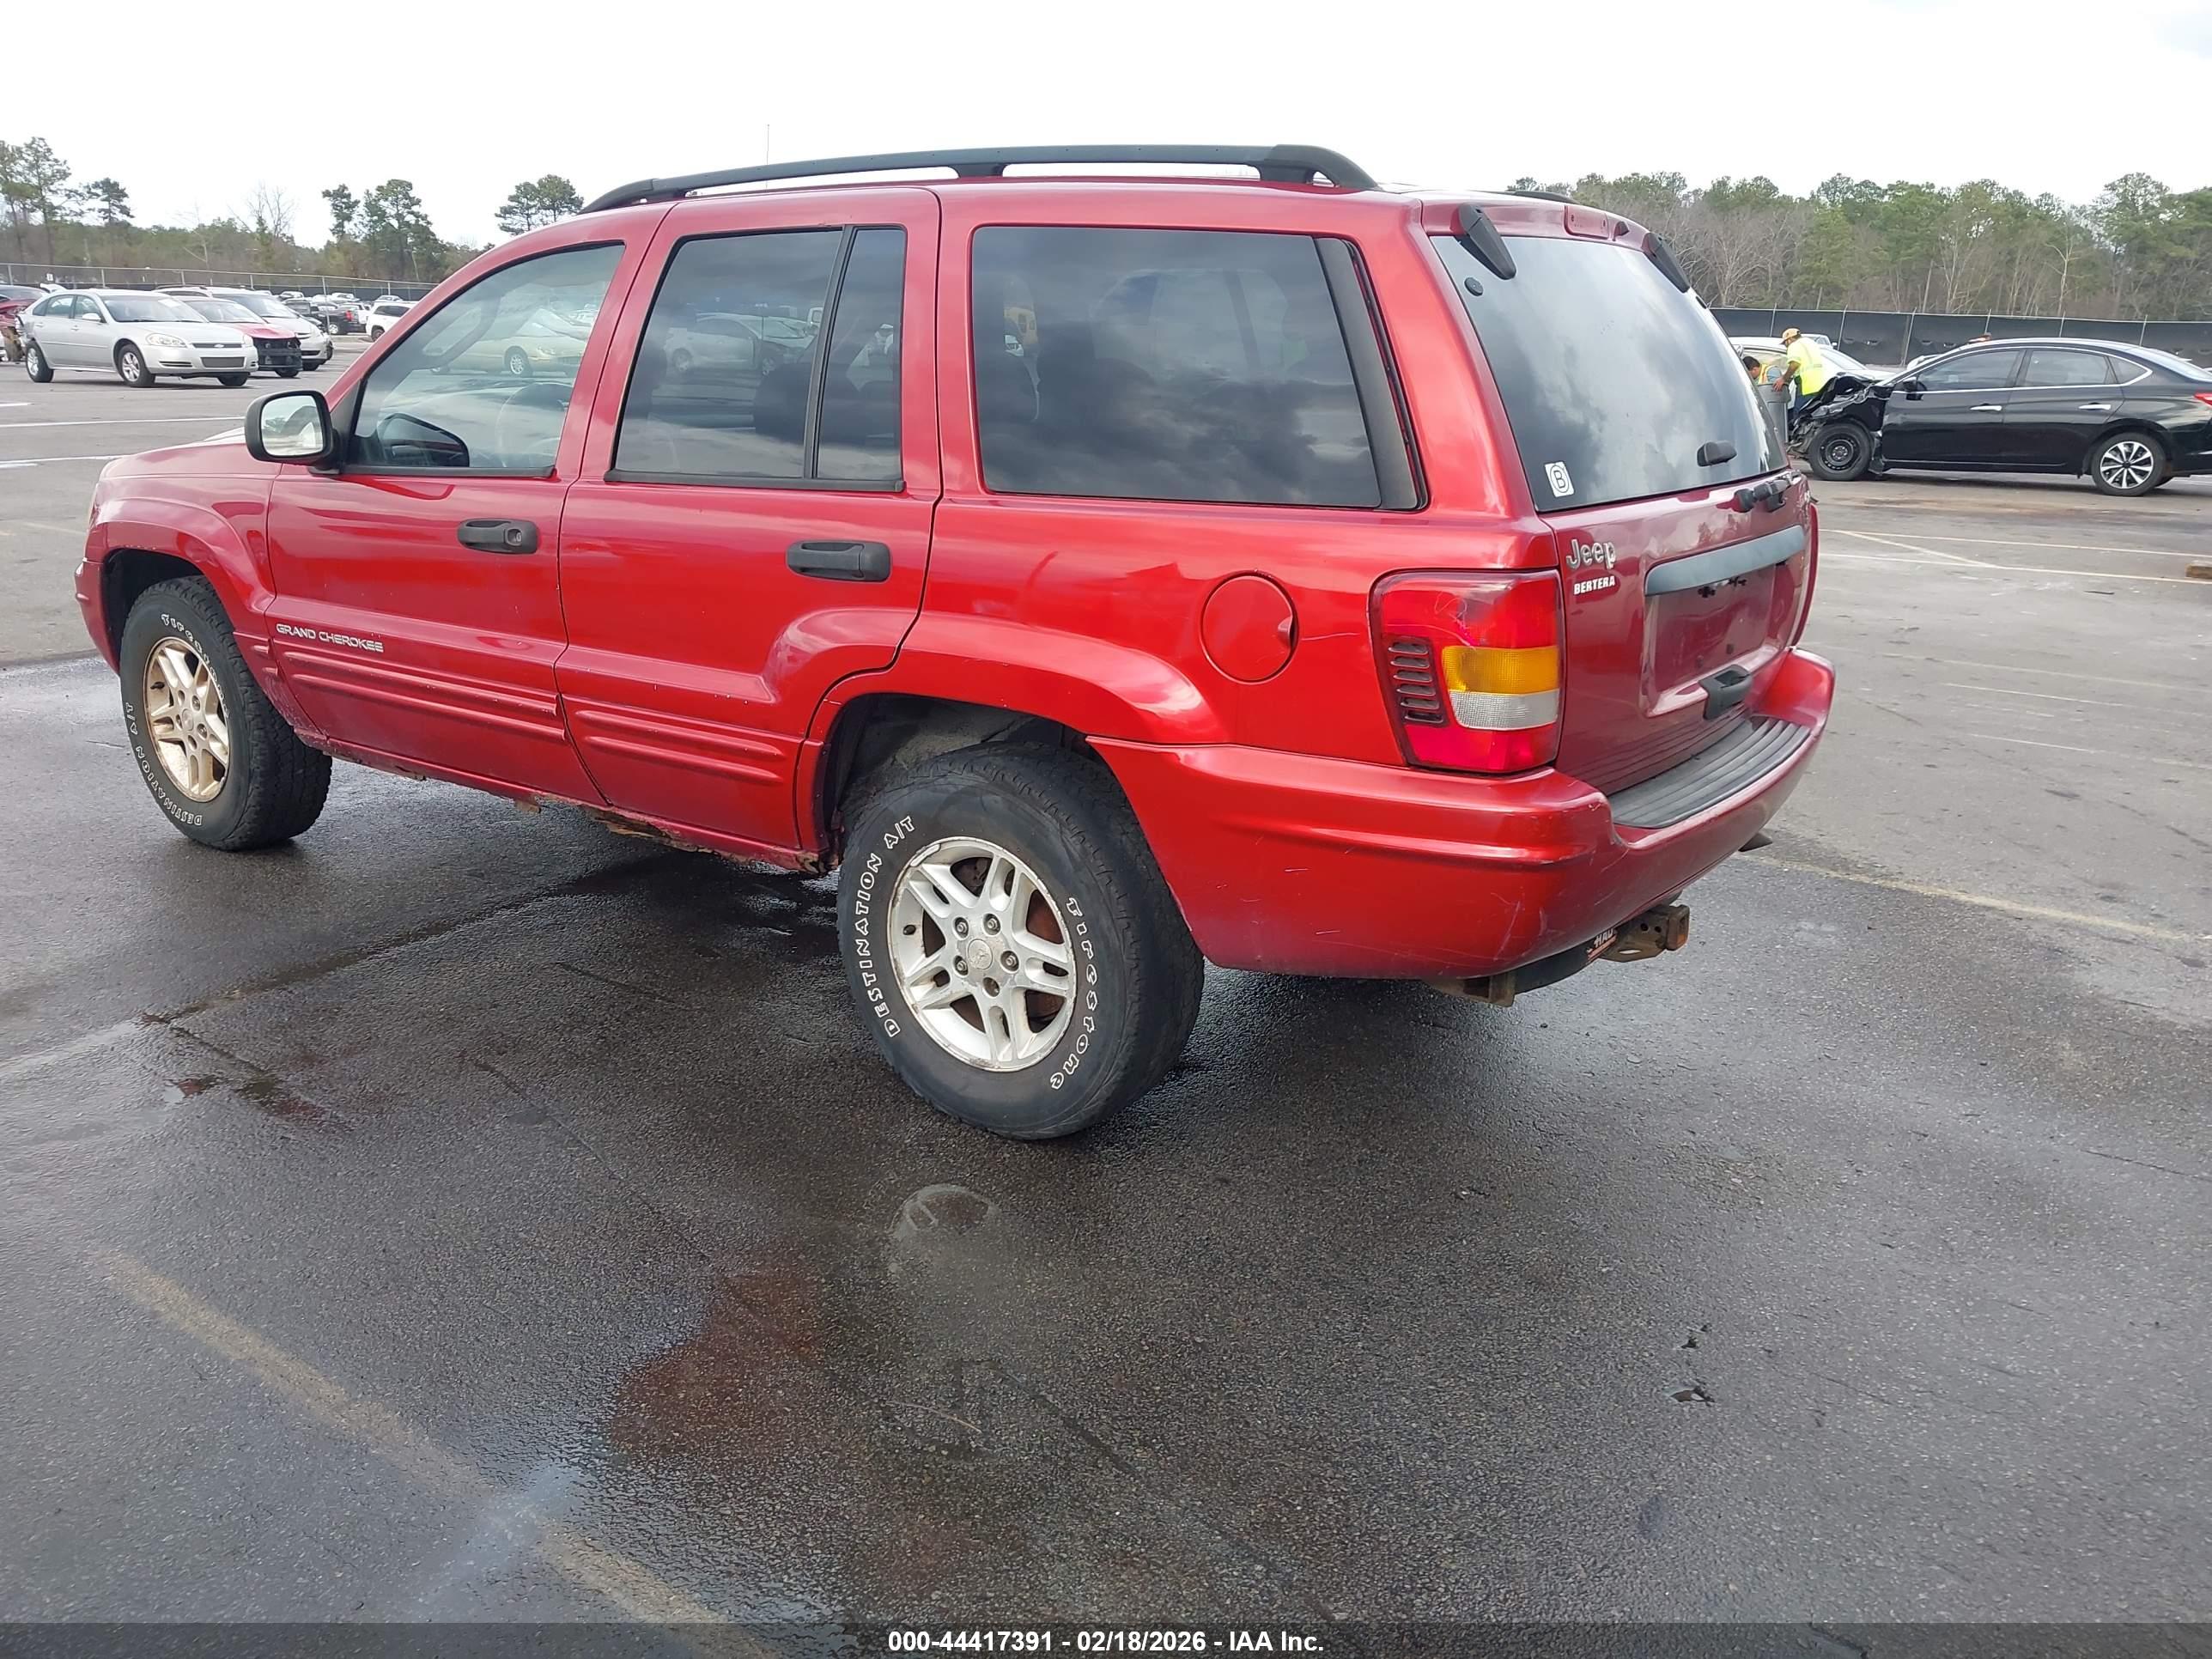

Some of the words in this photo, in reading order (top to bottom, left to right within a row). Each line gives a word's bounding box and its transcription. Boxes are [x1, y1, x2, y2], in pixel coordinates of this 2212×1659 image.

[1553, 470, 1566, 489] B
[1566, 538, 1617, 569] Jeep
[1573, 575, 1615, 595] BERTERA
[276, 623, 316, 640] GRAND
[319, 631, 384, 653] CHEROKEE
[125, 702, 138, 735] A/T
[136, 745, 203, 826] DESTINATION
[856, 853, 900, 1037] DESTINATION
[884, 816, 915, 849] A/T
[1050, 897, 1098, 1090] Firestone
